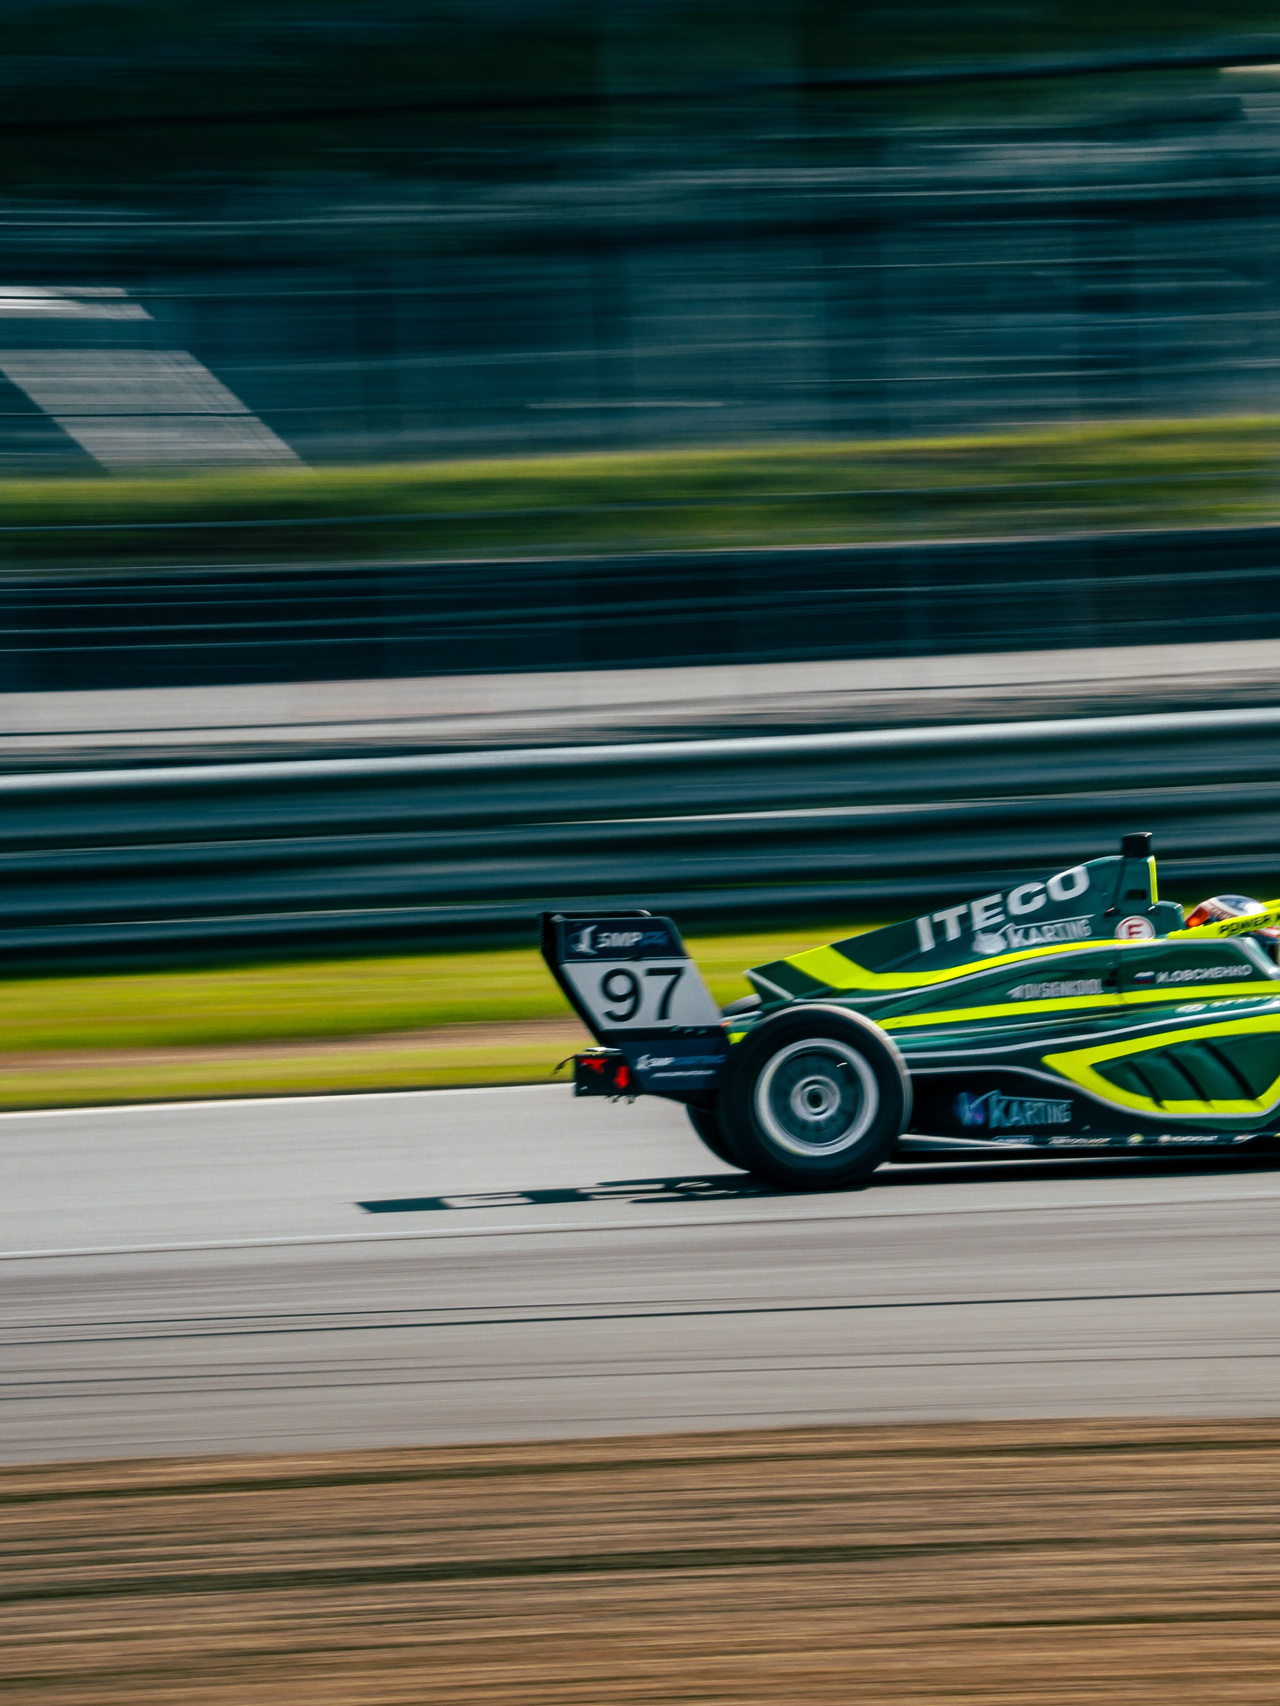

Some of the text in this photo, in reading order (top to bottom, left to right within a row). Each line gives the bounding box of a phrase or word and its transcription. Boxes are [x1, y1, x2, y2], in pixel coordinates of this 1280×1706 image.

[916, 865, 1090, 953] ITECO
[597, 931, 643, 947] SMP
[1008, 919, 1092, 948] KARTING
[1127, 924, 1143, 937] E
[1218, 914, 1271, 937] POWER
[600, 967, 685, 1022] 97
[988, 1095, 1073, 1129] KARTING
